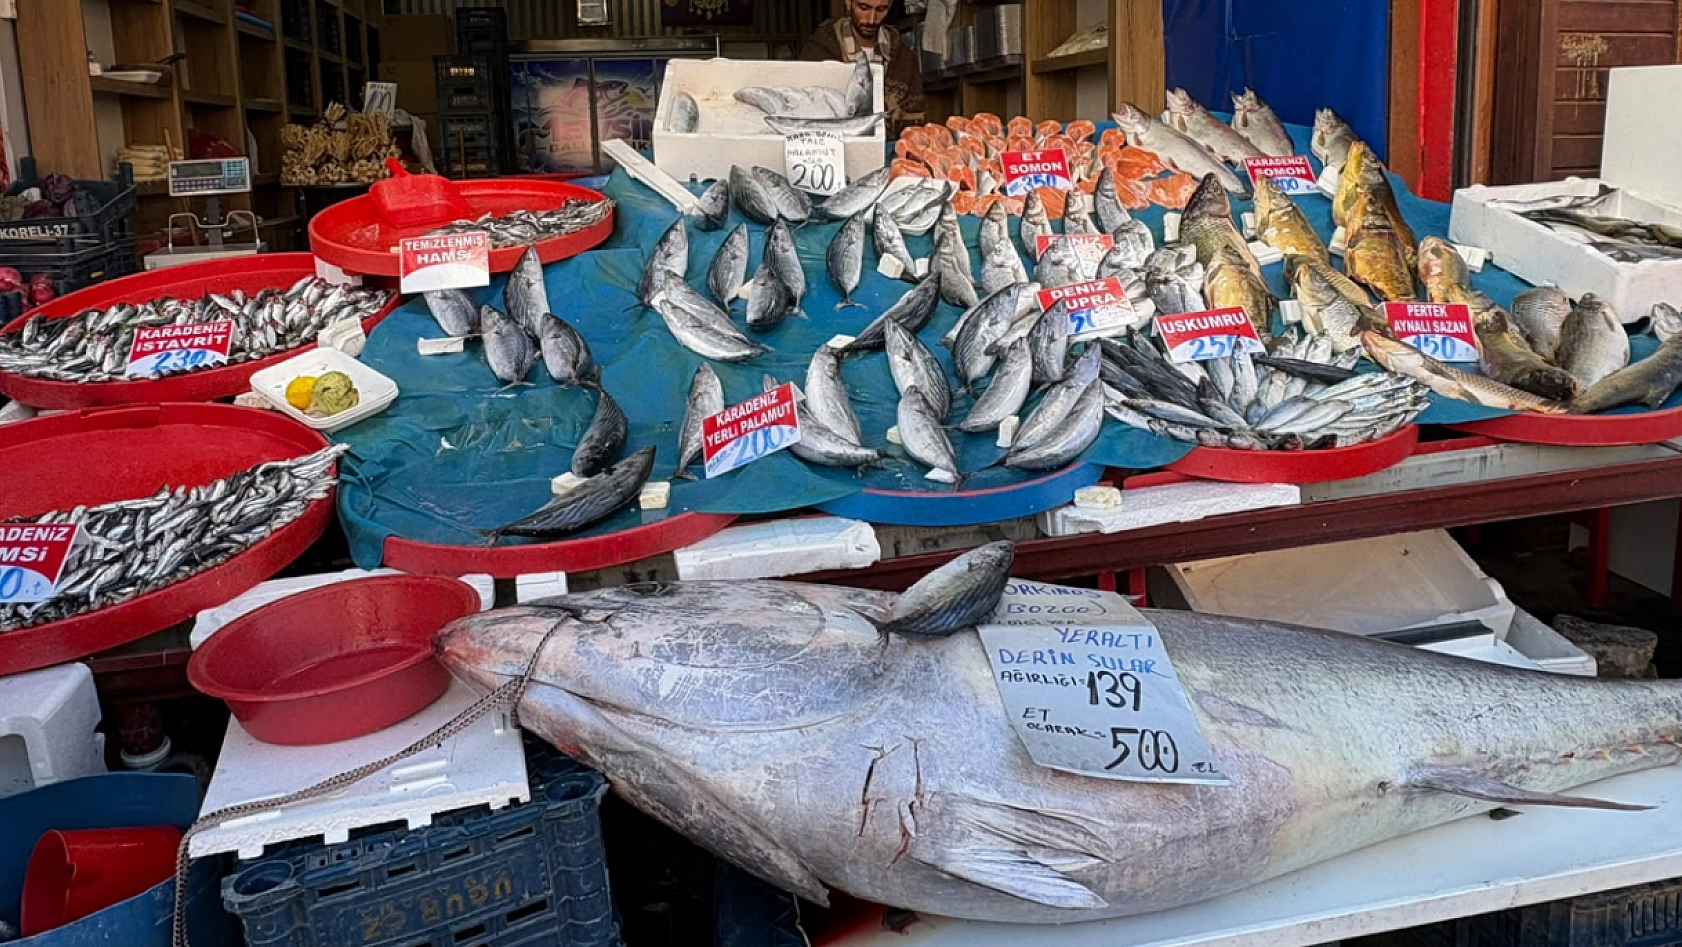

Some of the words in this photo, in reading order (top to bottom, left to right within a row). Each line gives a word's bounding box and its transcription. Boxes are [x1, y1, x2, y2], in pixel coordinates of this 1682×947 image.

[1022, 152, 1044, 161] ET
[792, 163, 835, 191] 200
[1009, 162, 1063, 175] SOMON
[1253, 166, 1307, 177] SOMON
[1064, 293, 1117, 310] UPRA
[1406, 304, 1448, 317] PERTEK
[1161, 311, 1247, 334] USKUMRU
[1394, 319, 1431, 332] AYNALI
[1433, 321, 1468, 334] SAZAN
[1413, 334, 1457, 360] 150
[740, 401, 792, 433] PALAMUT
[732, 425, 785, 468] 200
[1053, 627, 1153, 650] YERALTI
[999, 648, 1077, 666] DERİN
[1087, 652, 1168, 677] SULAR
[1086, 670, 1143, 711] 139
[1022, 706, 1051, 722] ET
[1104, 726, 1179, 774] 500
